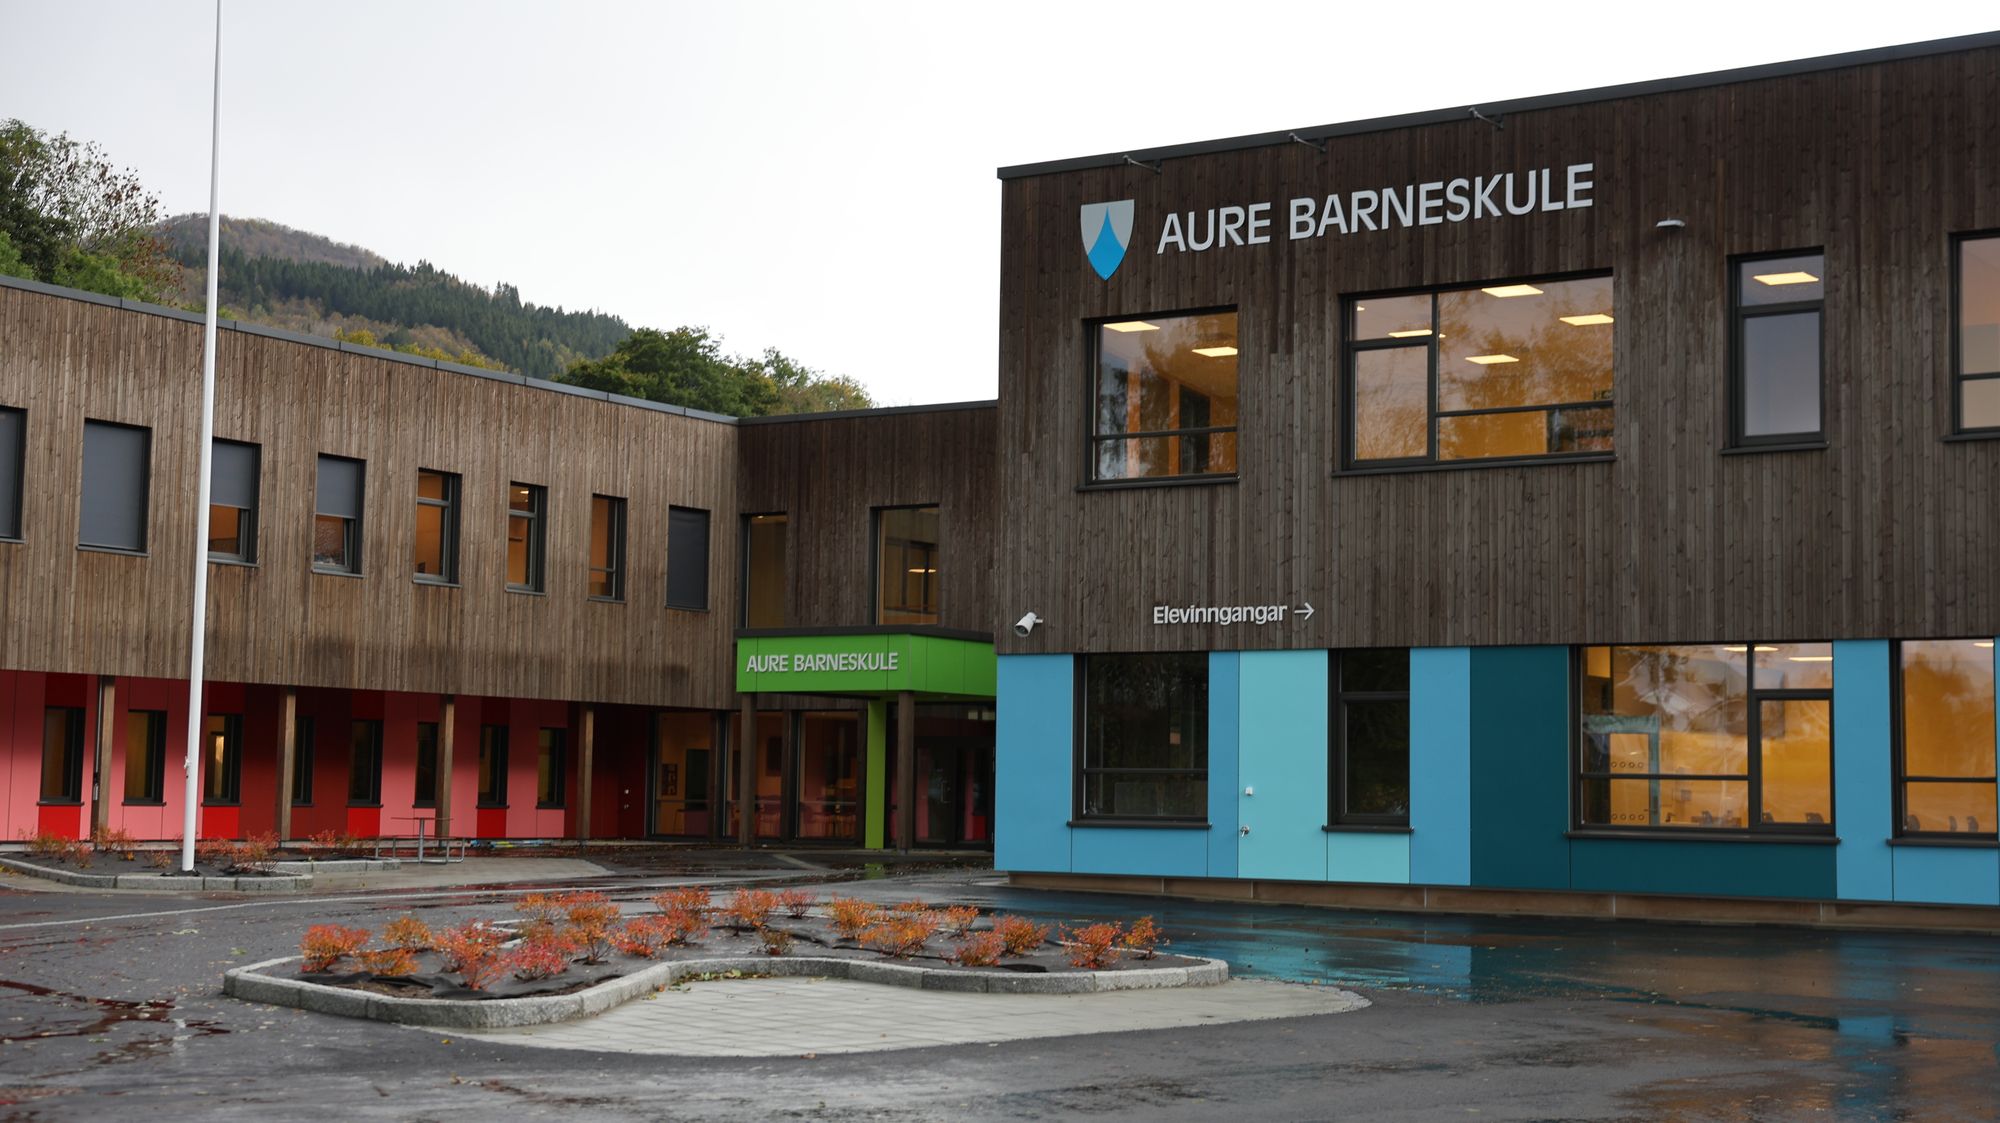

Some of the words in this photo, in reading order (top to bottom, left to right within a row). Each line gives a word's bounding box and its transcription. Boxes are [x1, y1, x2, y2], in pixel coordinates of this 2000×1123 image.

[1156, 202, 1271, 255] AURE
[1289, 163, 1594, 240] BARNESKULE
[1153, 605, 1287, 625] Elevinngangar
[746, 654, 789, 673] AURE
[794, 652, 898, 672] BARNESKULE
